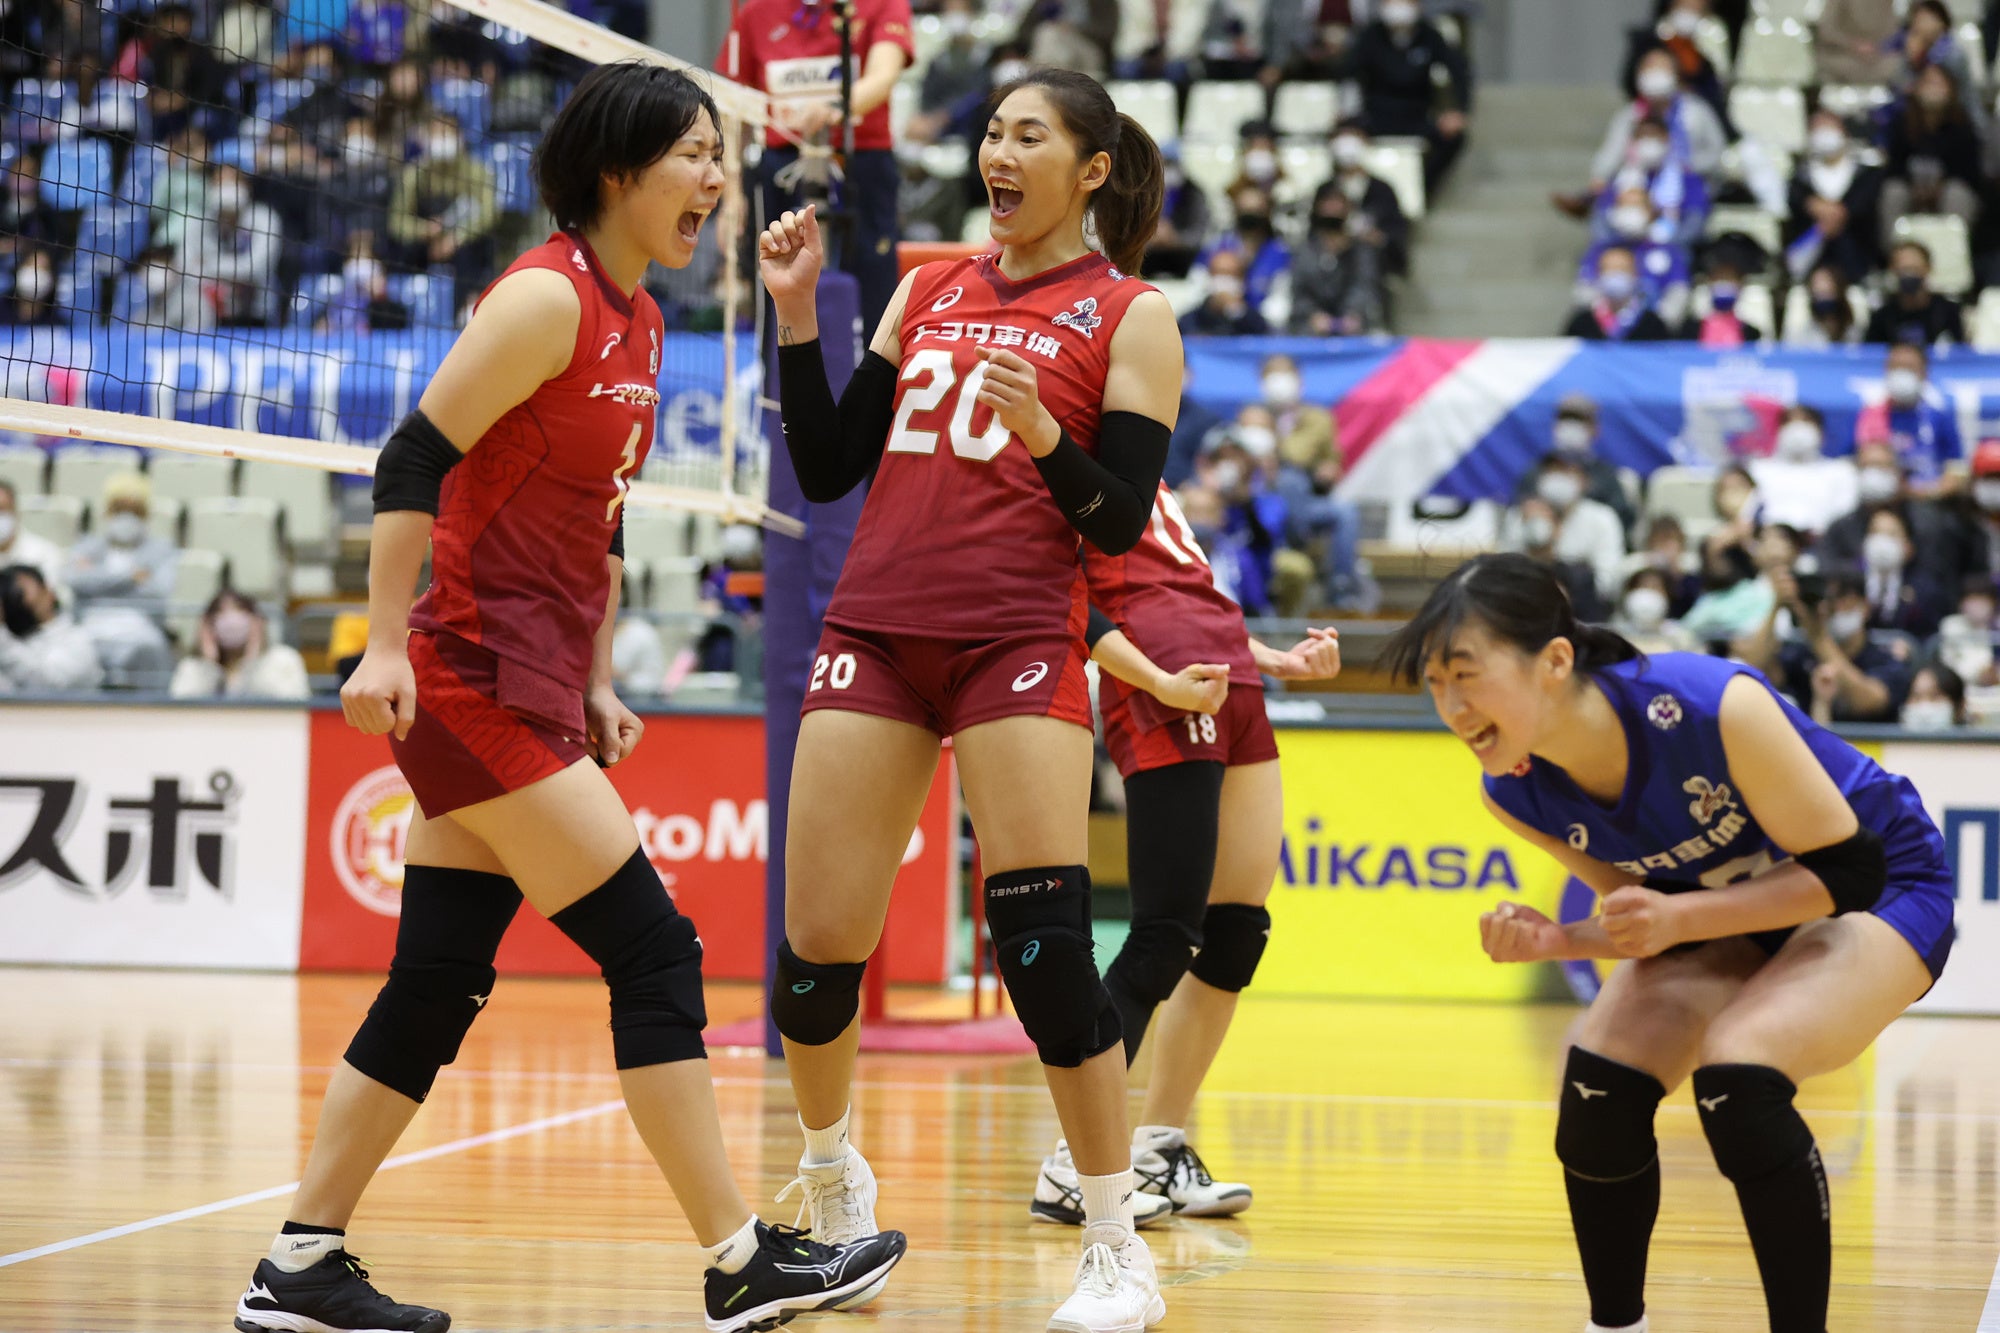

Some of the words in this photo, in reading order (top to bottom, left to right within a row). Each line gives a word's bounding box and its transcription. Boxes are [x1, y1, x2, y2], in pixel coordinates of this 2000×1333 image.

[912, 322, 1062, 360] トヨタ車体
[886, 349, 1012, 464] 20
[809, 653, 858, 693] 20
[1184, 713, 1217, 745] 18
[0, 770, 234, 894] スポ
